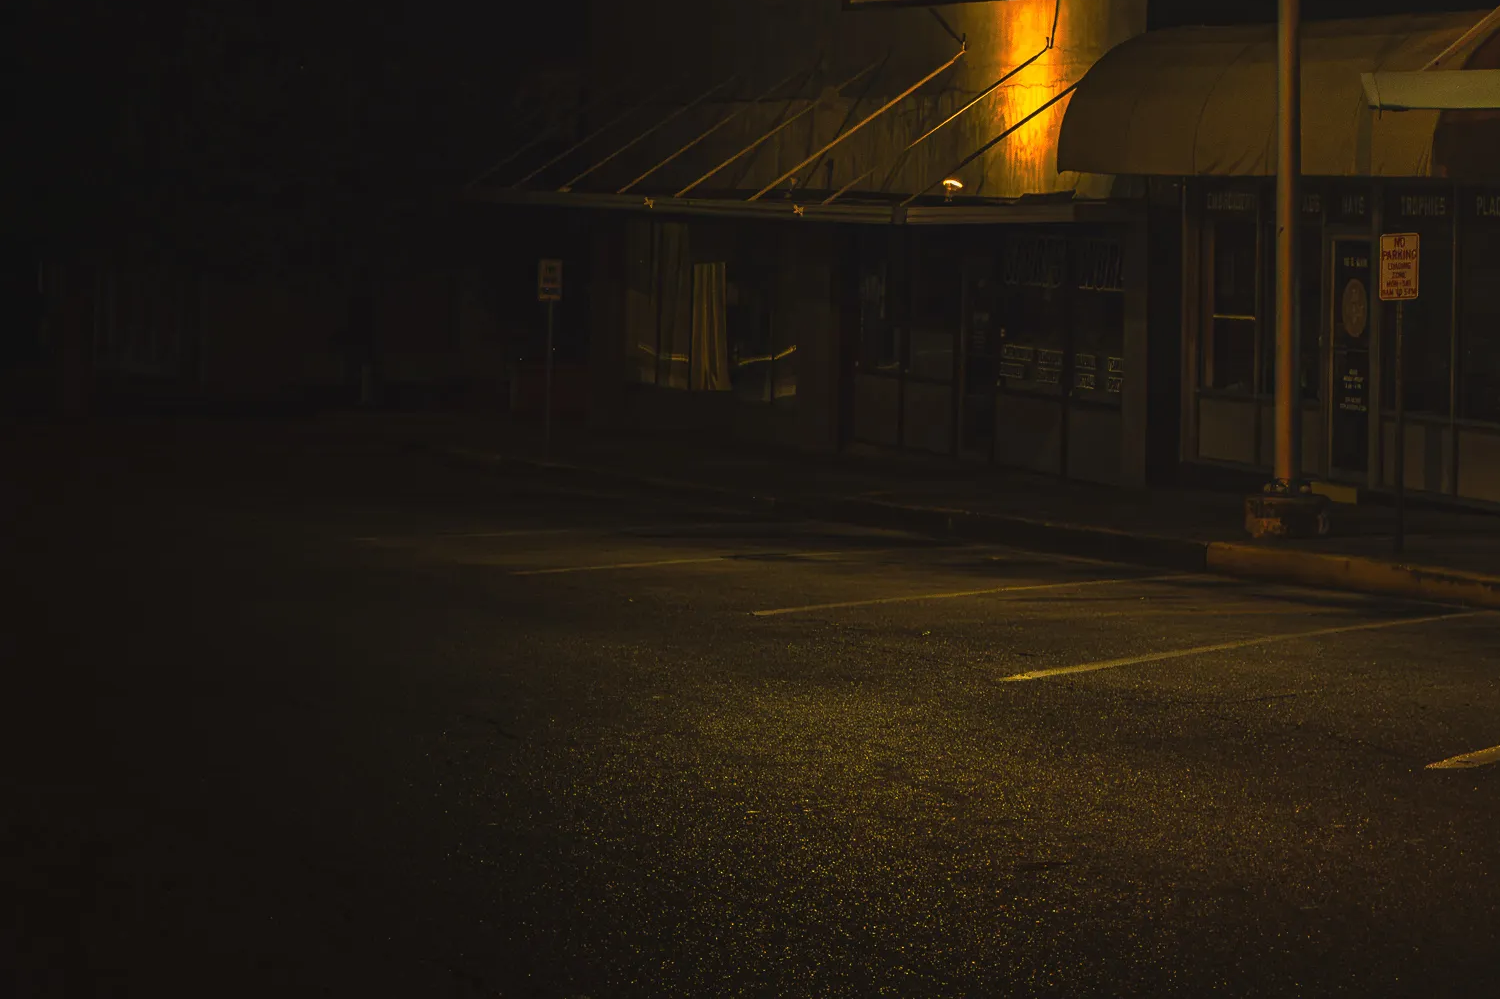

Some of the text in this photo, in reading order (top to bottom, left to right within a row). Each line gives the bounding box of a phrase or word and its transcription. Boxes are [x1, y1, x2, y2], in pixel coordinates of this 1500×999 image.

[1401, 195, 1446, 216] TROPHIES
[1394, 237, 1406, 248] NO
[1382, 249, 1417, 260] PARKING
